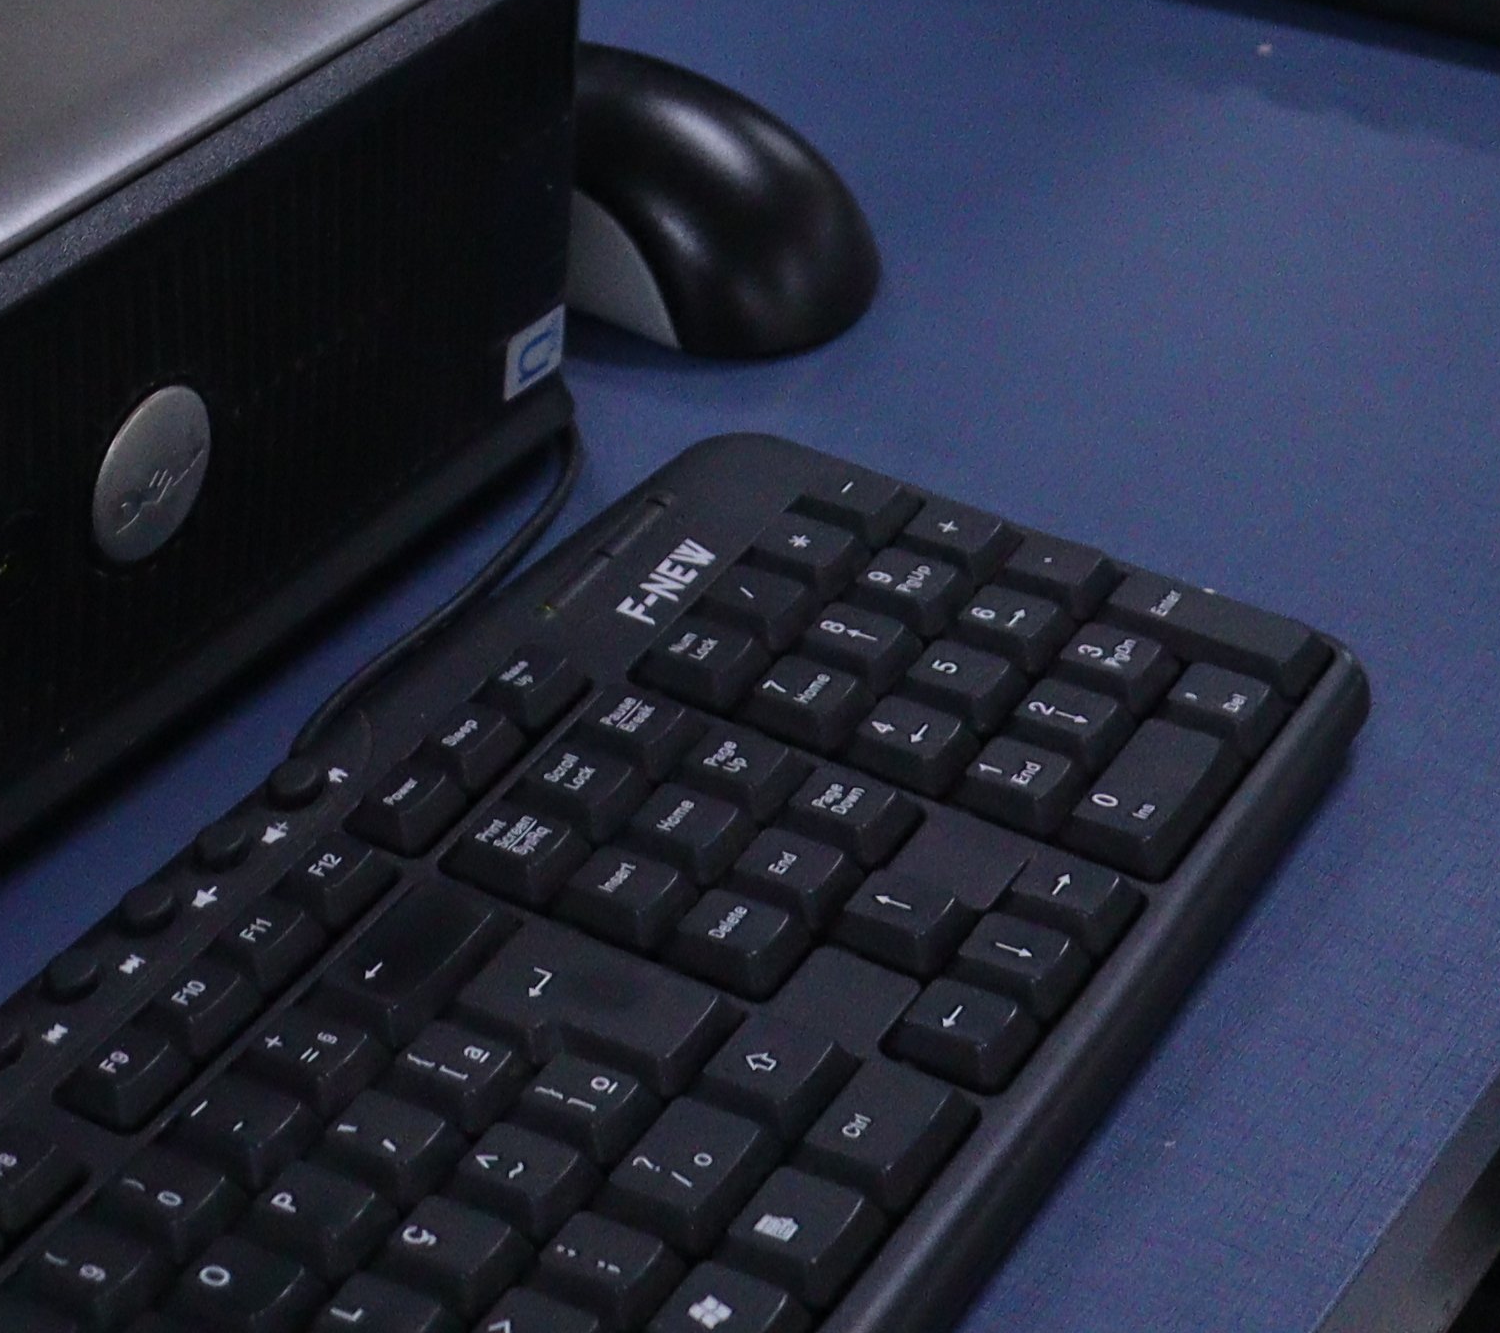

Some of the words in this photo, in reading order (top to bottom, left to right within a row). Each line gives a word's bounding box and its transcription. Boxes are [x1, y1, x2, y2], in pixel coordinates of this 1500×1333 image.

[615, 537, 717, 626] F-NEW
[867, 569, 893, 585] 9
[894, 564, 933, 594] PgUp
[819, 619, 847, 634] 8
[970, 606, 997, 621] 6
[687, 637, 720, 661] Lock
[1077, 642, 1104, 659] 3
[931, 658, 959, 675] 5
[762, 678, 788, 695] 7
[792, 672, 832, 706] Home
[599, 696, 638, 726] Pause
[615, 704, 656, 733] Break
[1027, 700, 1056, 717] 2
[441, 719, 479, 747] Sleep
[870, 719, 896, 734] 4
[702, 740, 738, 767] Page
[722, 756, 749, 773] Up
[543, 752, 581, 783] Scroll
[563, 765, 597, 791] Lock
[1010, 760, 1042, 787] End
[811, 783, 845, 810] Page
[830, 786, 866, 816] Down
[655, 799, 696, 833] Home
[307, 852, 343, 878] F12
[767, 851, 798, 876] End
[597, 862, 637, 894] Insert
[239, 917, 273, 943] F11
[707, 905, 749, 939] Delete
[170, 979, 207, 1007] F10
[99, 1050, 131, 1075] F9
[841, 1113, 872, 1139] Ctrl
[270, 1191, 299, 1214] P
[401, 1224, 438, 1247] Ç
[199, 1264, 231, 1288] O
[329, 1306, 364, 1324] L
